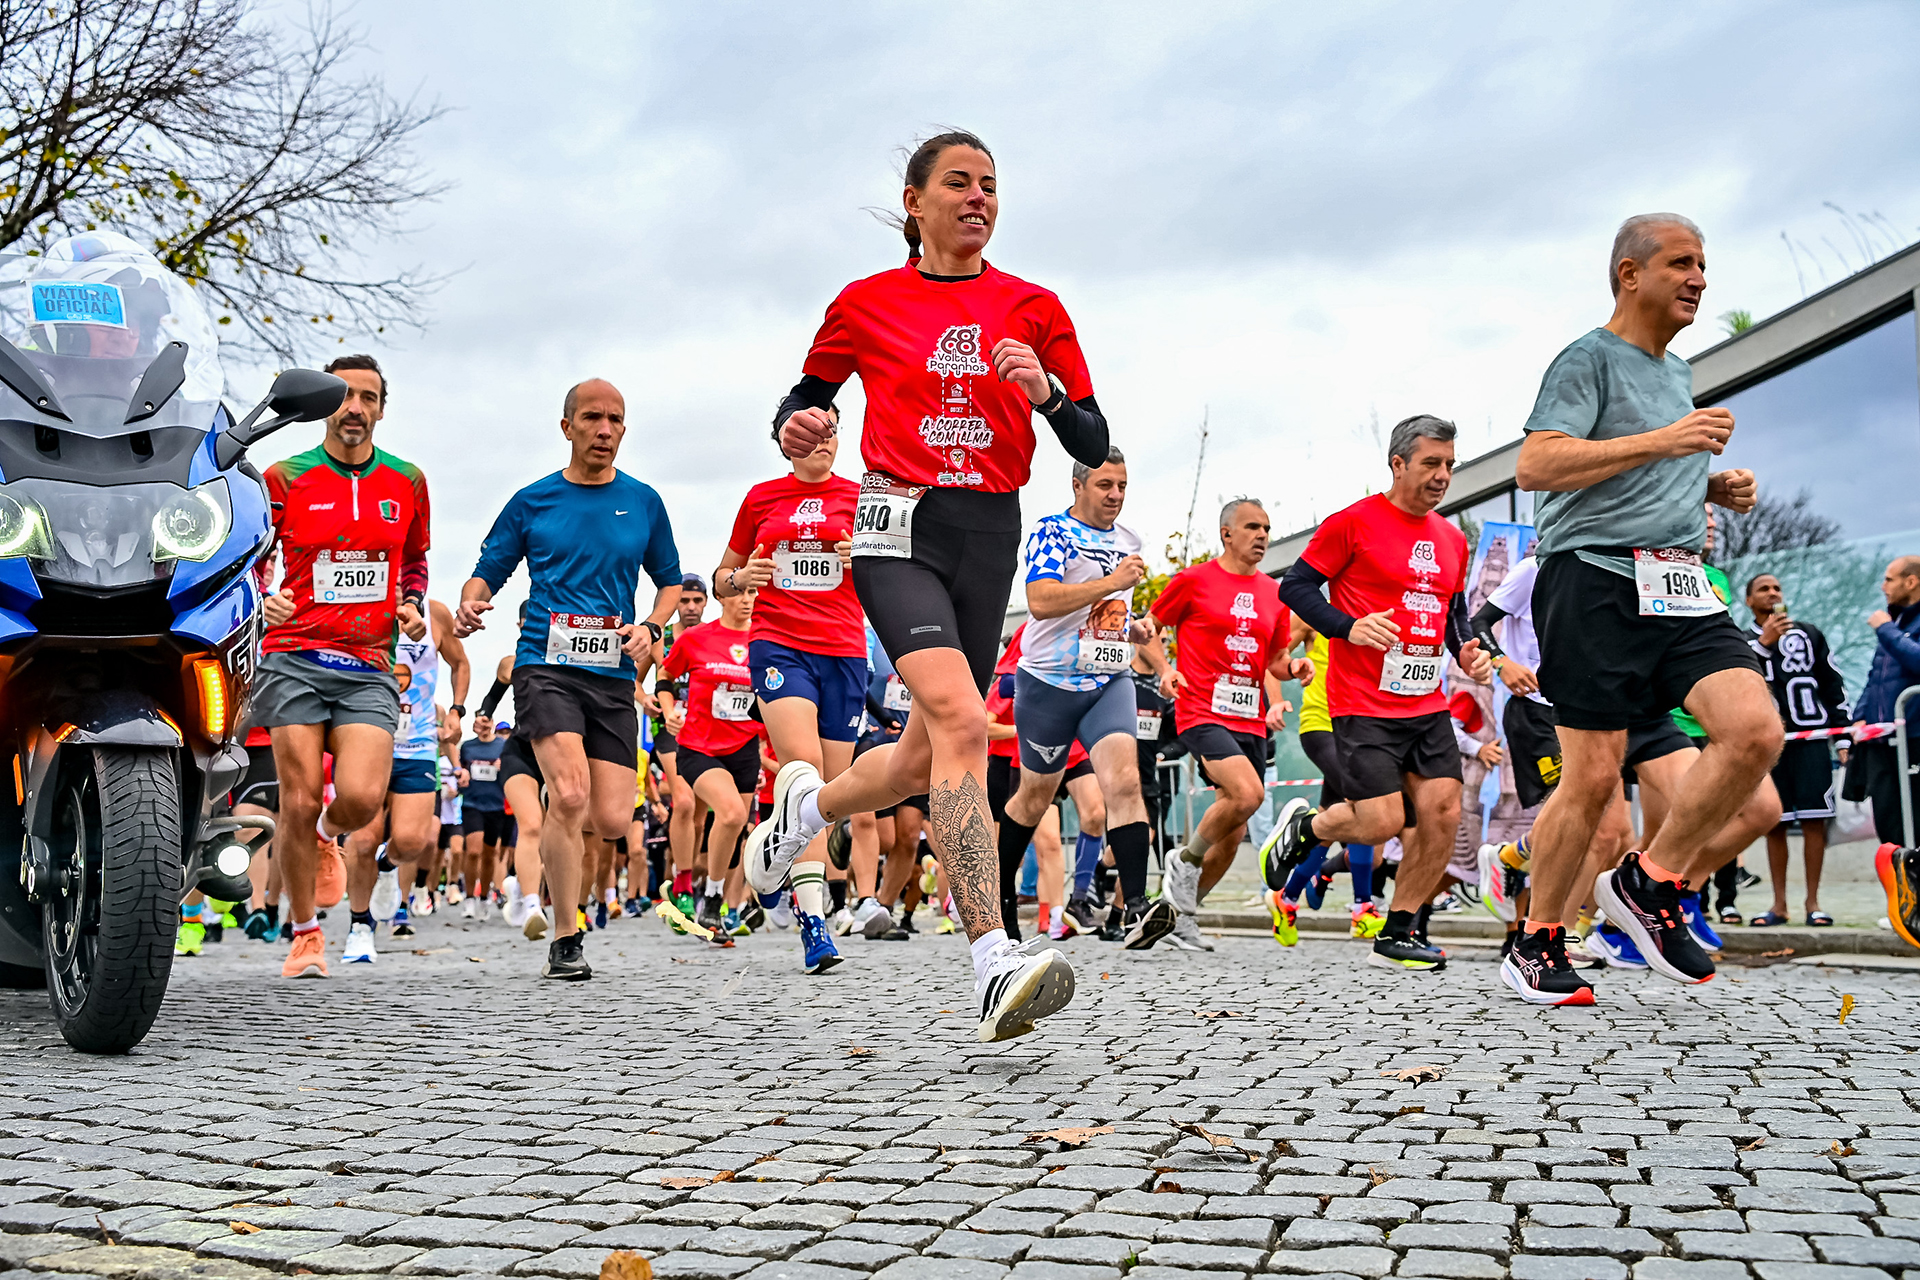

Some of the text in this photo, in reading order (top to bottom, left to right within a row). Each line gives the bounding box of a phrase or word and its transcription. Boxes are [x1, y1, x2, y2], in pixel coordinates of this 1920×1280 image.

[38, 287, 113, 302] VIATURA
[45, 299, 112, 315] OFICIAL
[937, 348, 968, 363] Volta
[930, 360, 986, 376] Paranhos
[922, 419, 983, 432] A CORRER
[928, 430, 990, 445] COM ALMA
[862, 475, 892, 492] geas
[793, 541, 822, 552] ageas
[335, 550, 368, 562] ageas
[792, 559, 830, 577] 1086
[333, 570, 376, 588] 2502
[1662, 572, 1700, 598] 1938
[572, 615, 605, 629] ageas
[570, 636, 609, 654] 1564
[1407, 644, 1434, 657] ageas
[317, 652, 371, 668] SPOR
[569, 657, 613, 665] StatusMarathon
[1094, 647, 1124, 663] 2596
[1401, 663, 1436, 681] 2059
[732, 697, 749, 710] 778
[1231, 691, 1253, 707] 1341
